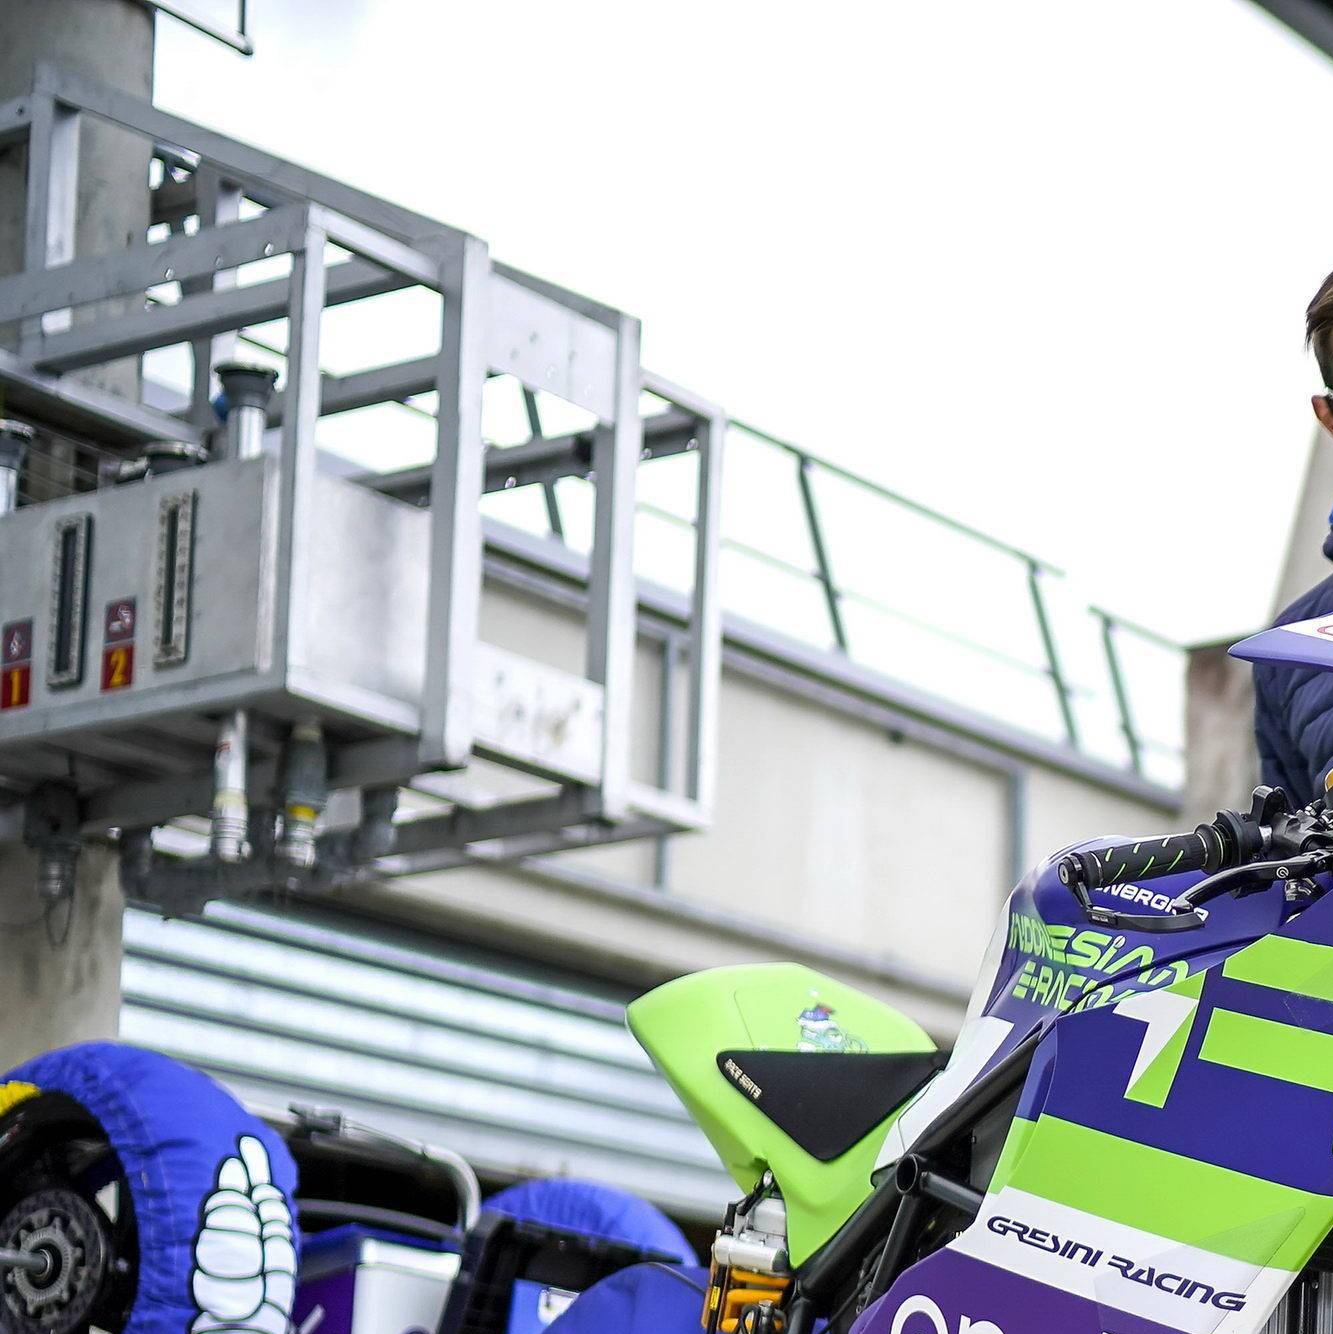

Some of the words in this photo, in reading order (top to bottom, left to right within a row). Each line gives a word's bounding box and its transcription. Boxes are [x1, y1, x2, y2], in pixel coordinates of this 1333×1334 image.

[9, 669, 20, 705] 1
[110, 647, 126, 688] 2
[987, 1215, 1103, 1268] GRESINI
[1107, 1255, 1248, 1313] RACING
